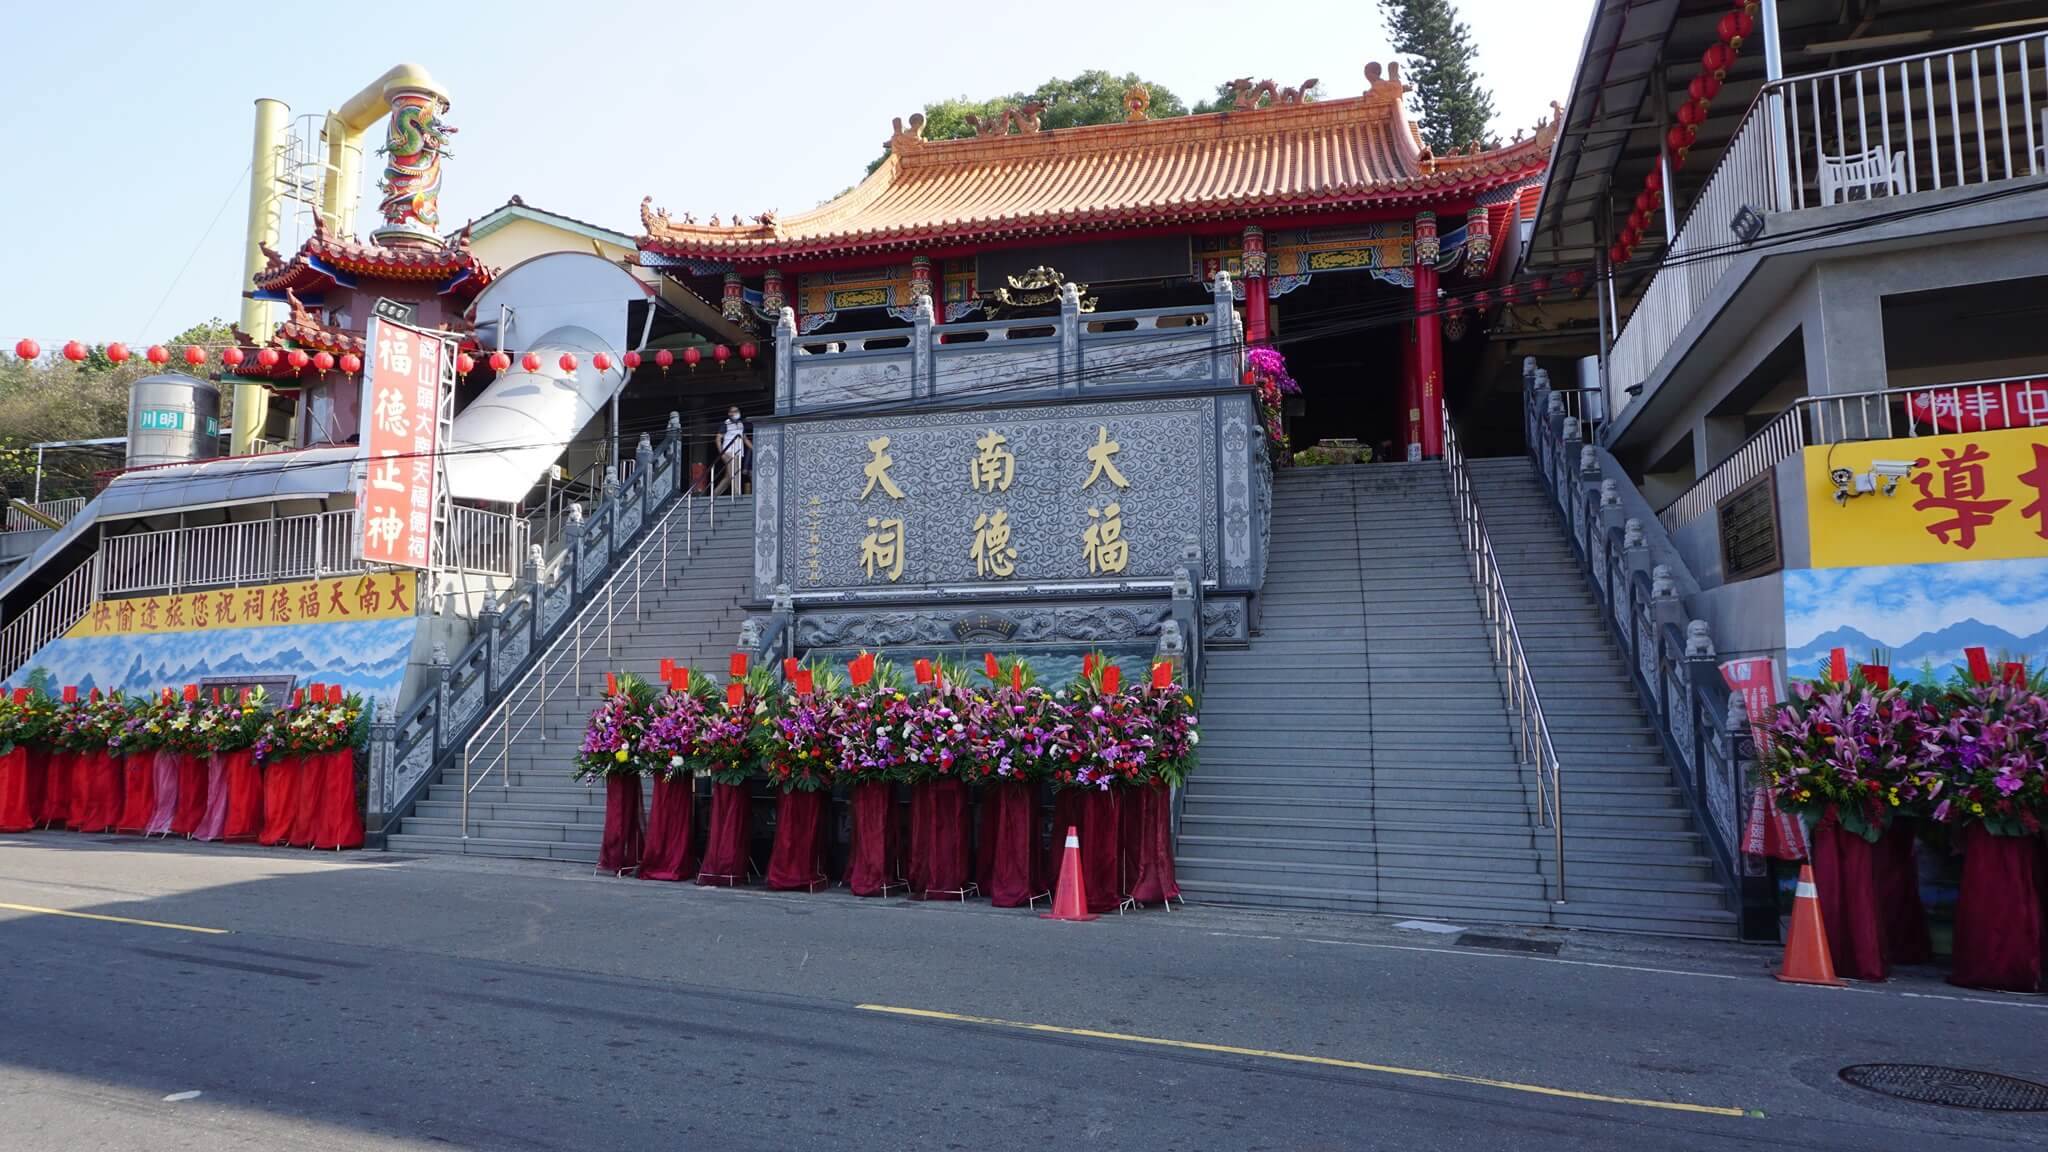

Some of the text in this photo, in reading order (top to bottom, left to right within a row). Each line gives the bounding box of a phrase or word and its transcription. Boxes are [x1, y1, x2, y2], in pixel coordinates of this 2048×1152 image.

[142, 410, 178, 429] 川明
[366, 326, 412, 556] 福德正神
